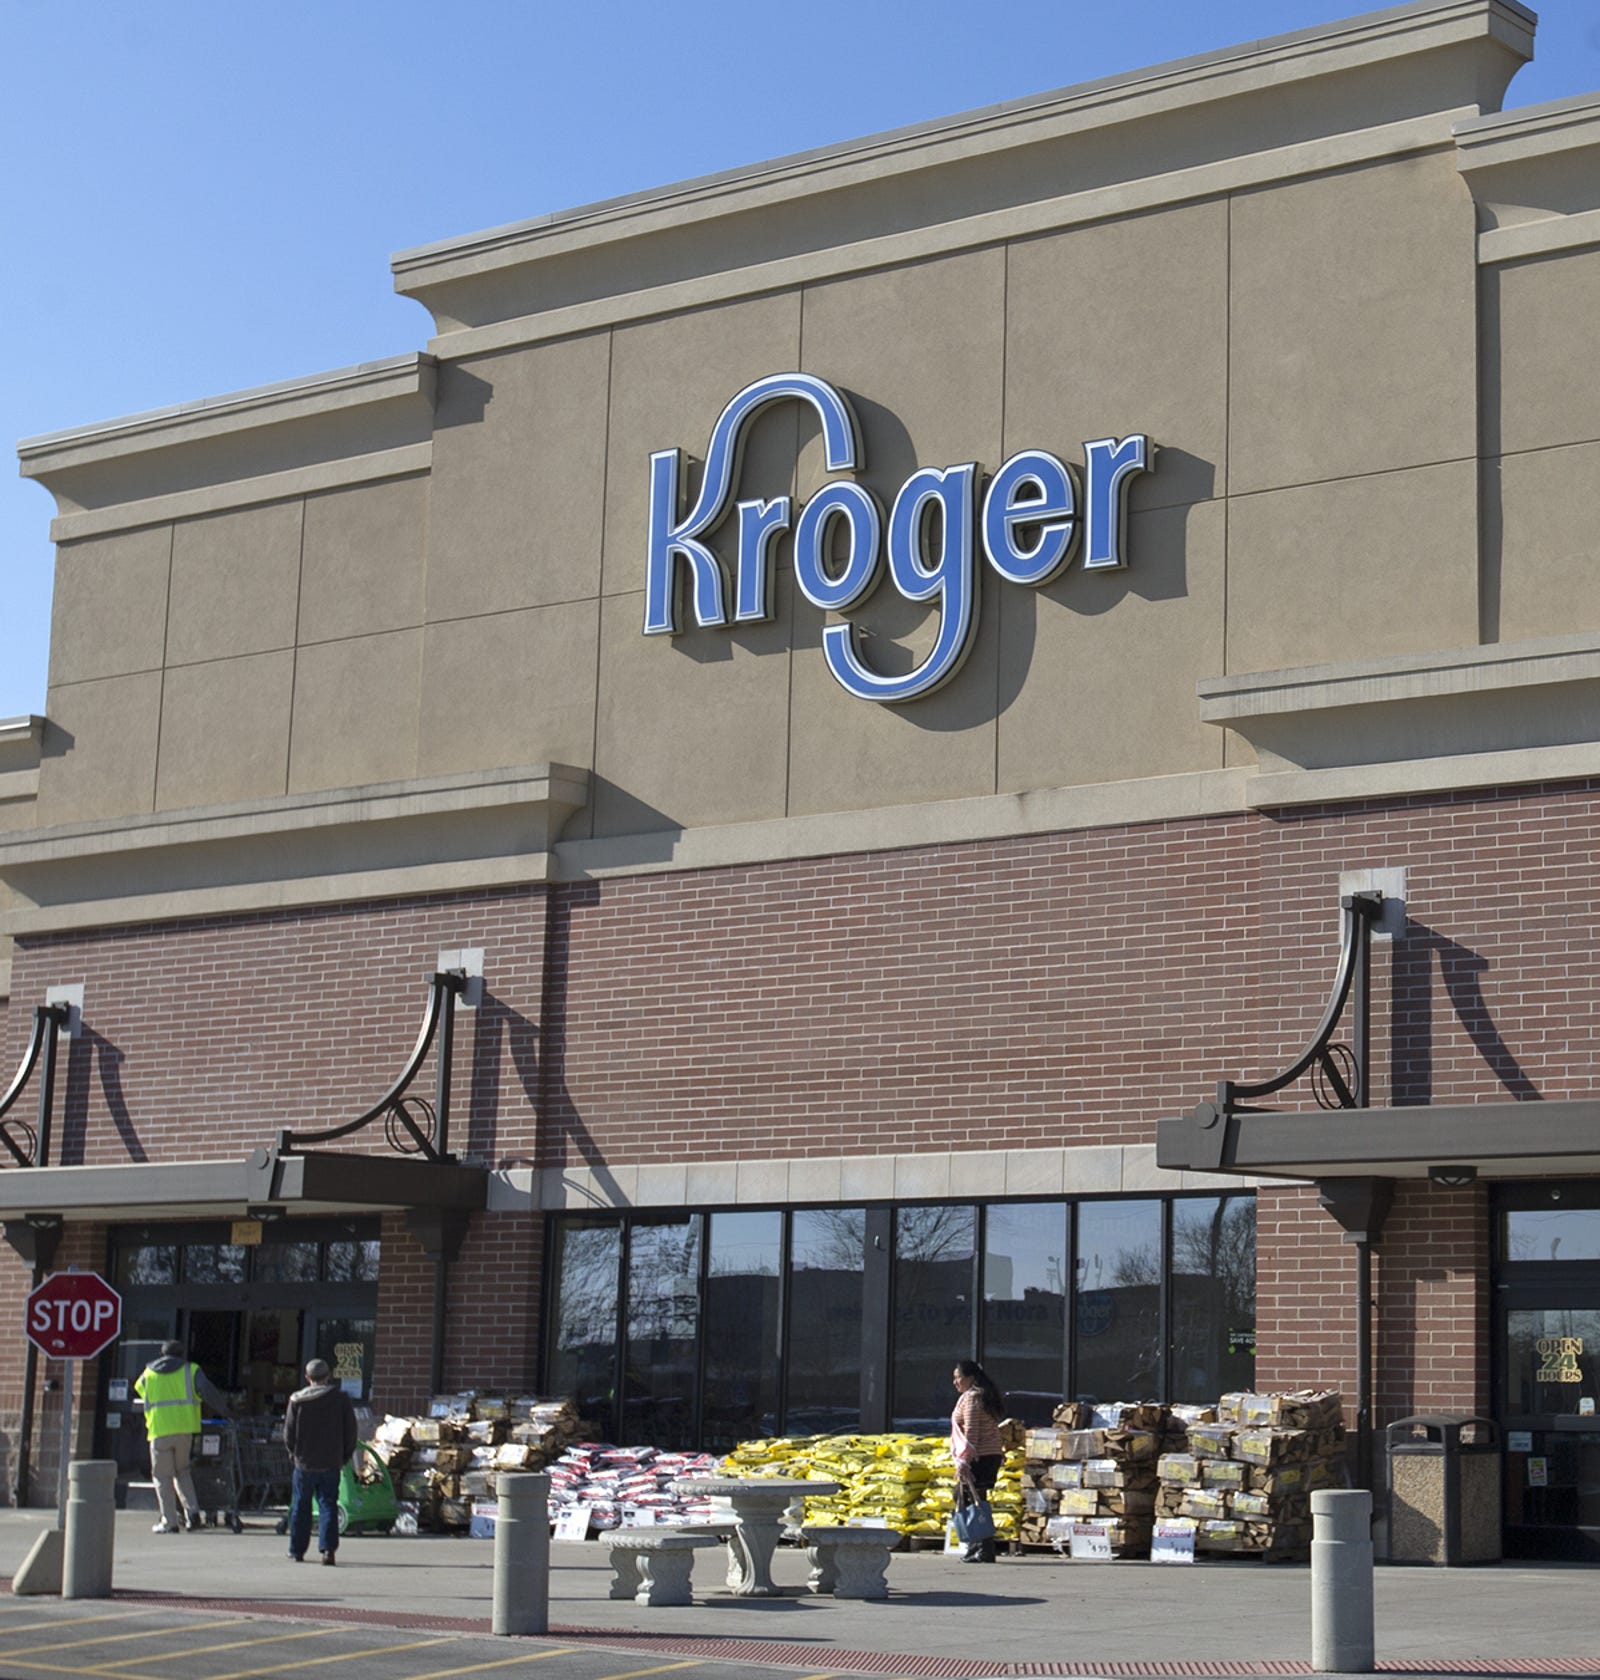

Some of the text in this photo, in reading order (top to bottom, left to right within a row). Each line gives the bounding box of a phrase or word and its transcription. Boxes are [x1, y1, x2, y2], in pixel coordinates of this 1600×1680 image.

[643, 371, 1154, 702] Kroger
[32, 1299, 115, 1332] STOP
[1536, 1338, 1583, 1354] OPEN
[338, 1355, 359, 1369] 24
[1542, 1353, 1577, 1369] 24
[1536, 1369, 1583, 1382] HOURS
